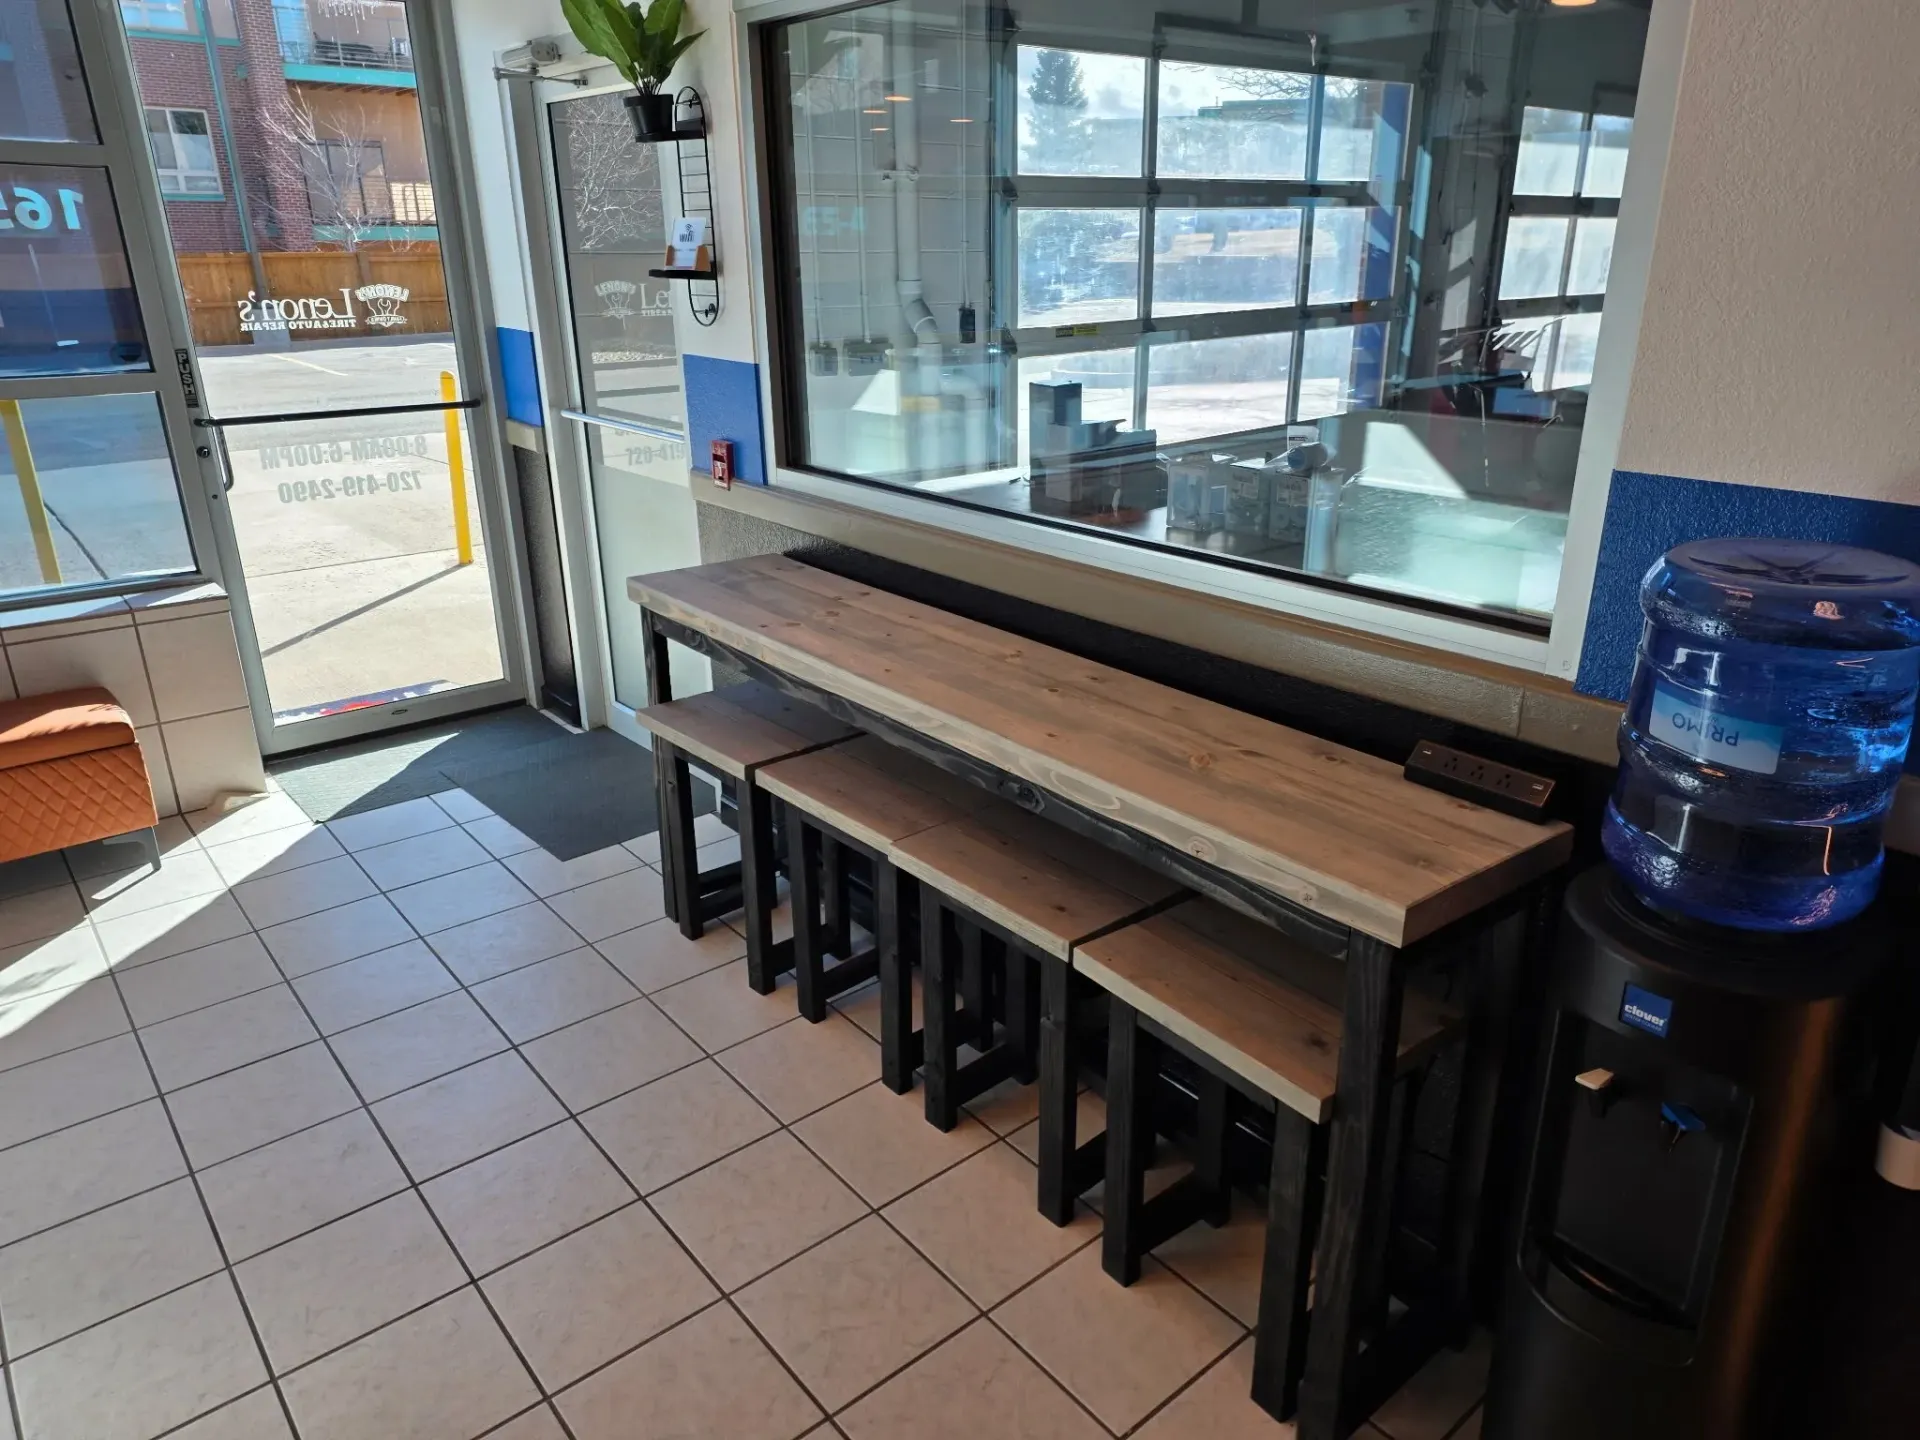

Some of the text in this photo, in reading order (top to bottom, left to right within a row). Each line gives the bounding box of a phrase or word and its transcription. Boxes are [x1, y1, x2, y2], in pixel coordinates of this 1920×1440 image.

[176, 352, 196, 395] PUSH
[1671, 711, 1740, 748] PRIMO
[1623, 1003, 1665, 1028] clover
